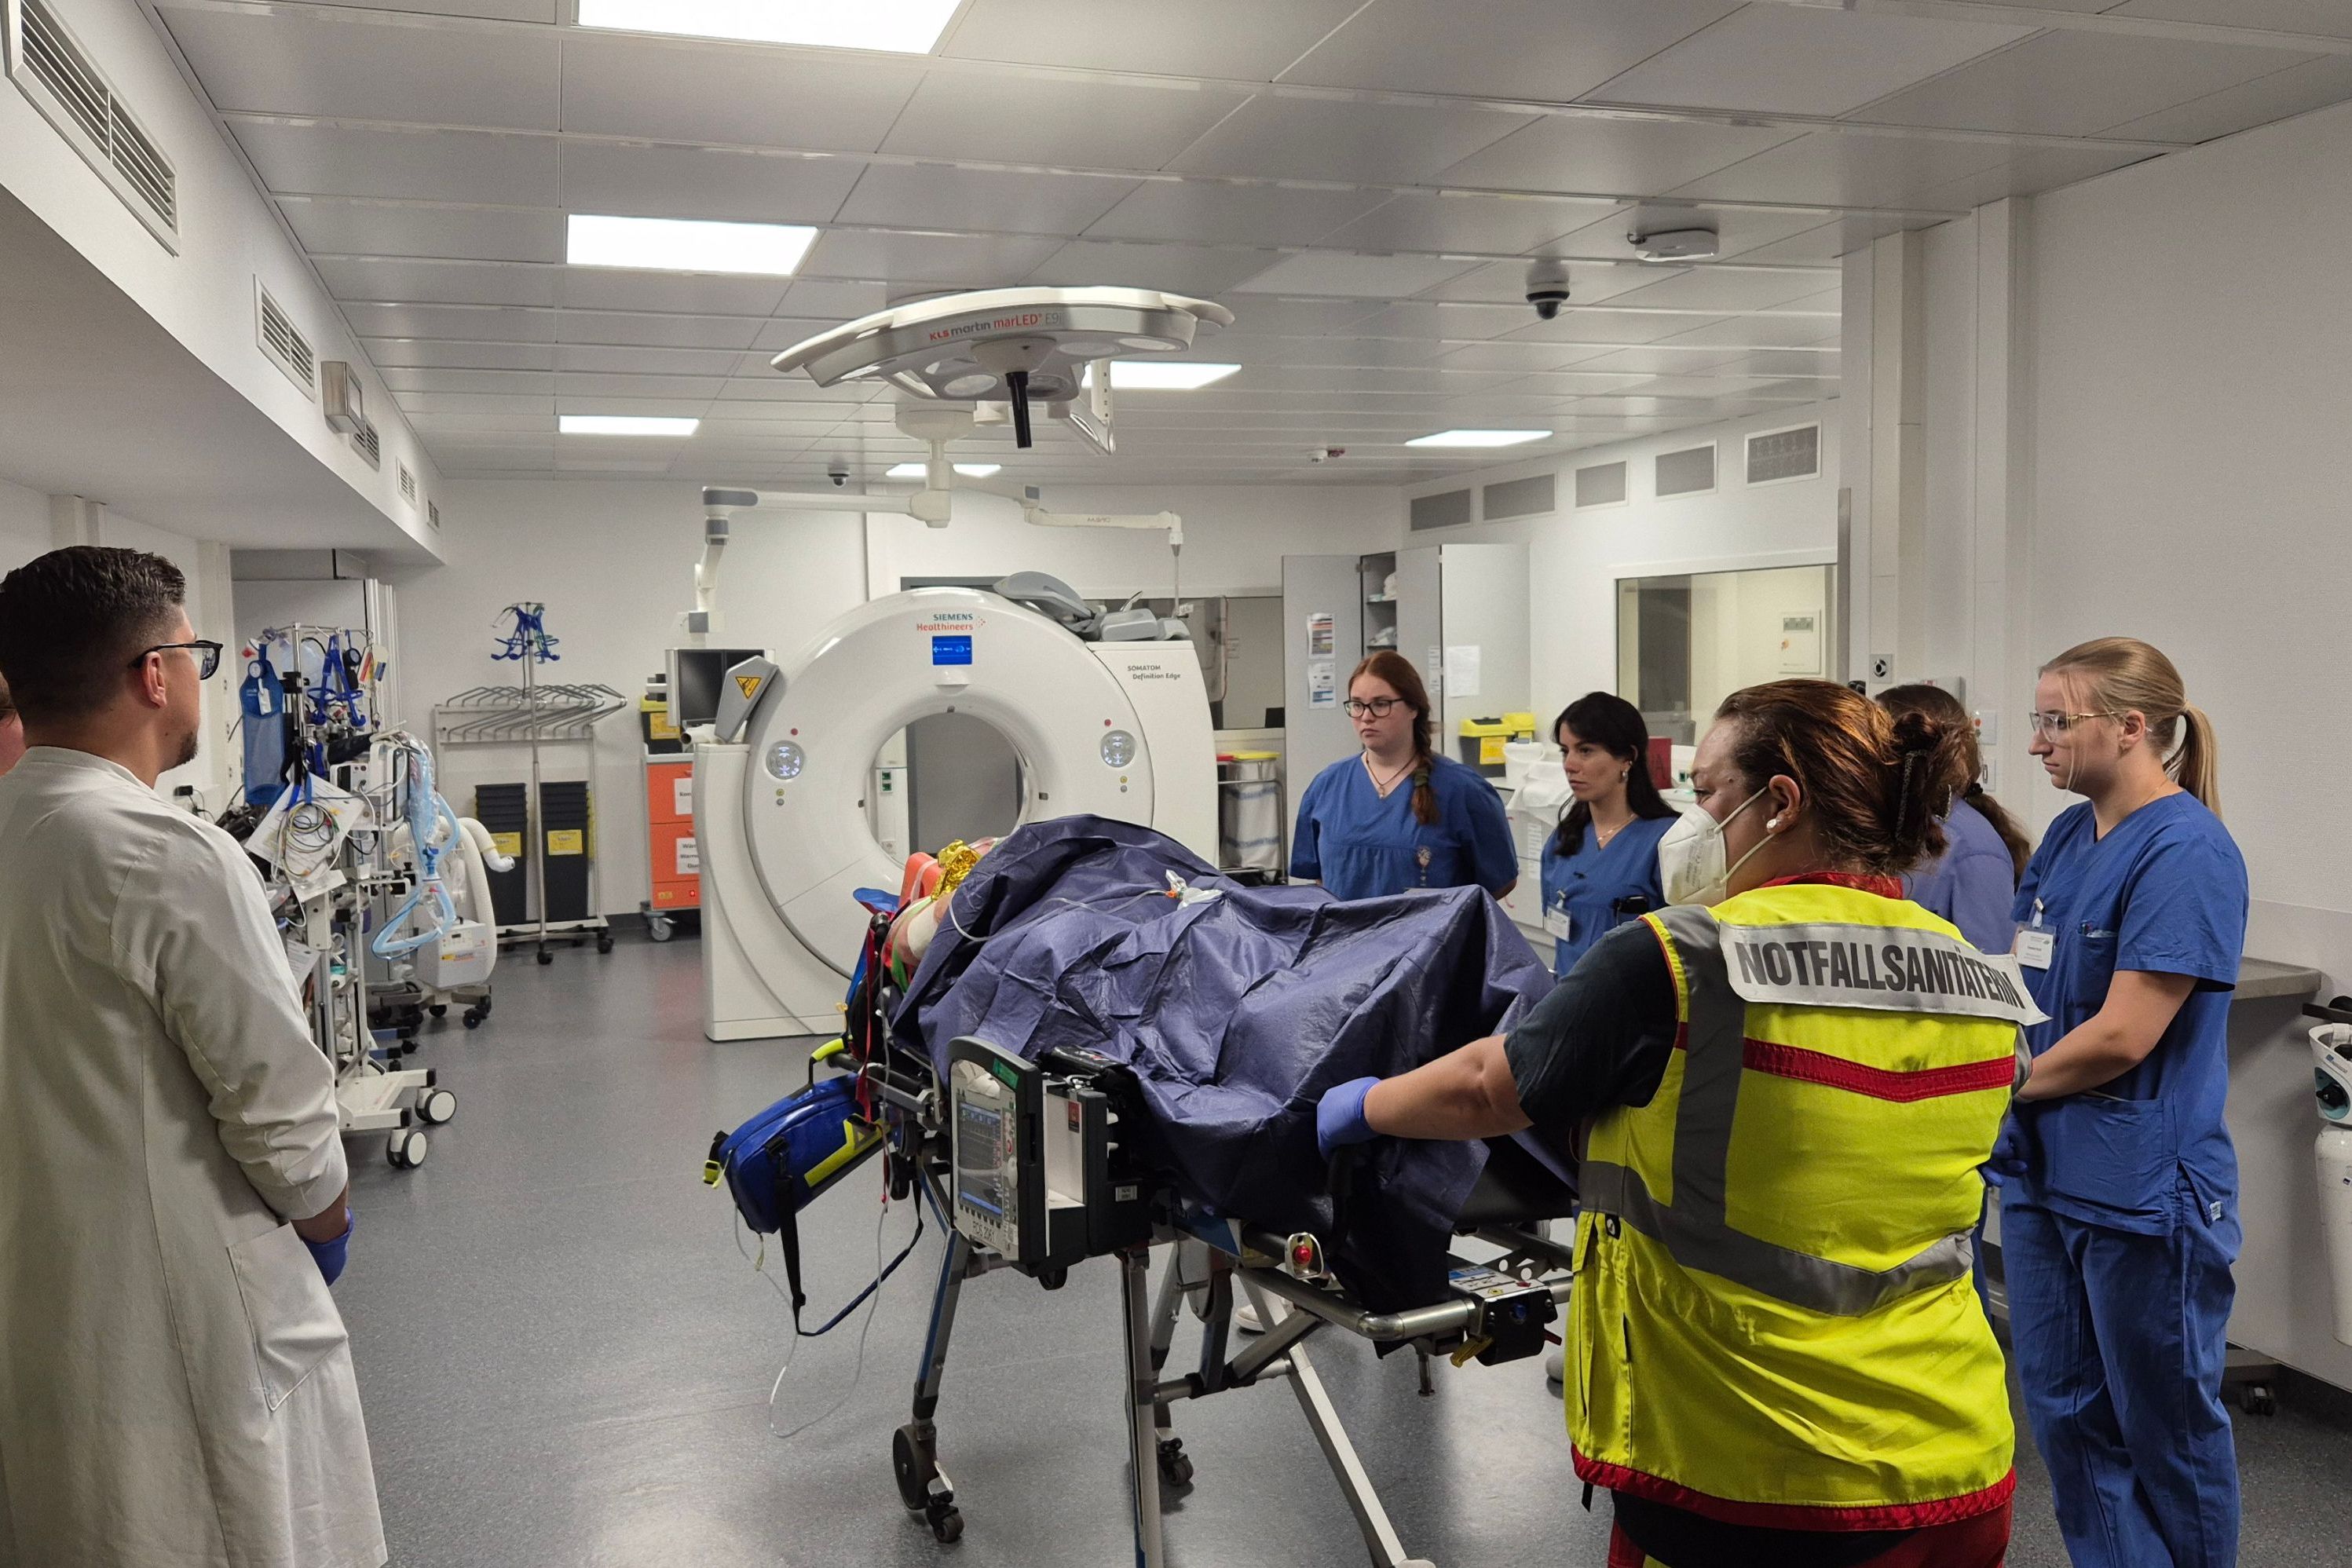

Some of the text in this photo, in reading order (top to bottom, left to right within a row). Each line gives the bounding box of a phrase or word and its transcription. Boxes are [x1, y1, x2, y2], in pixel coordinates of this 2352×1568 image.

[929, 331, 949, 341] KLS
[950, 321, 991, 337] martin
[916, 623, 974, 631] Healthineers
[1735, 941, 2026, 1010] NOTFALLSANITÄTERIN
